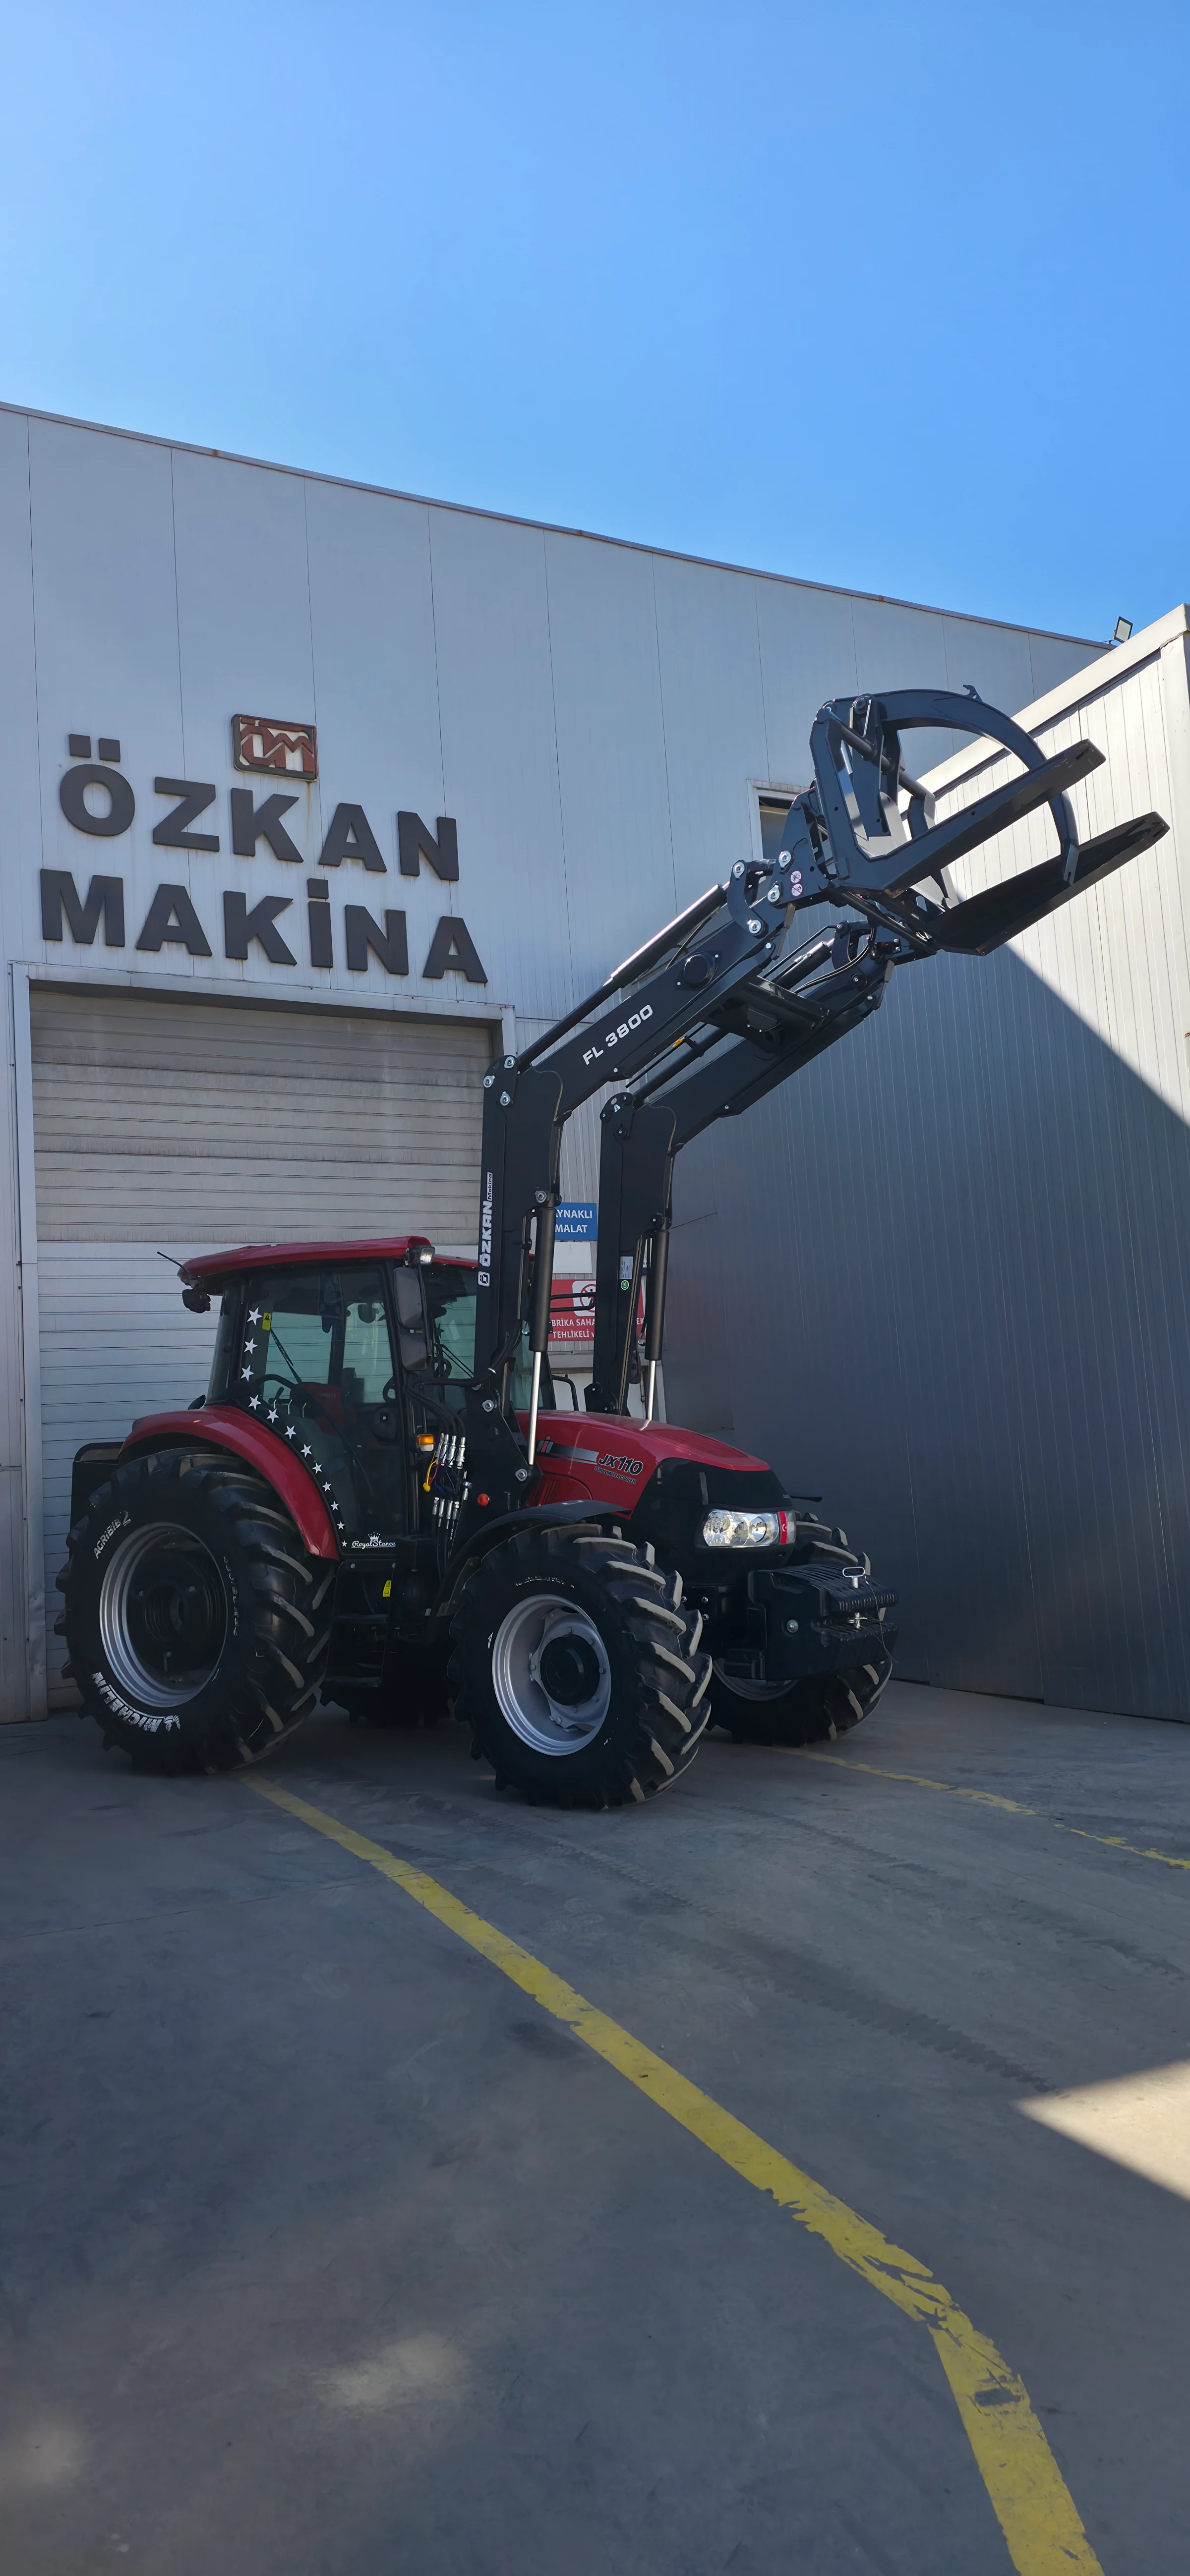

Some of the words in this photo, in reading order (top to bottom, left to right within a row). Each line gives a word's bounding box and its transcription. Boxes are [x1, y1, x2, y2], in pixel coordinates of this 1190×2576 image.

[60, 734, 459, 881] ÖZKAN
[40, 868, 488, 983] MAKİNA
[583, 1046, 604, 1065] FL
[605, 1005, 653, 1047] 3800
[479, 1201, 492, 1267] ÖZKAN
[553, 1329, 589, 1338] TEHLİKELİ
[598, 1453, 644, 1475] JX110
[122, 1510, 131, 1527] 2
[91, 1672, 162, 1732] MICHELIN
